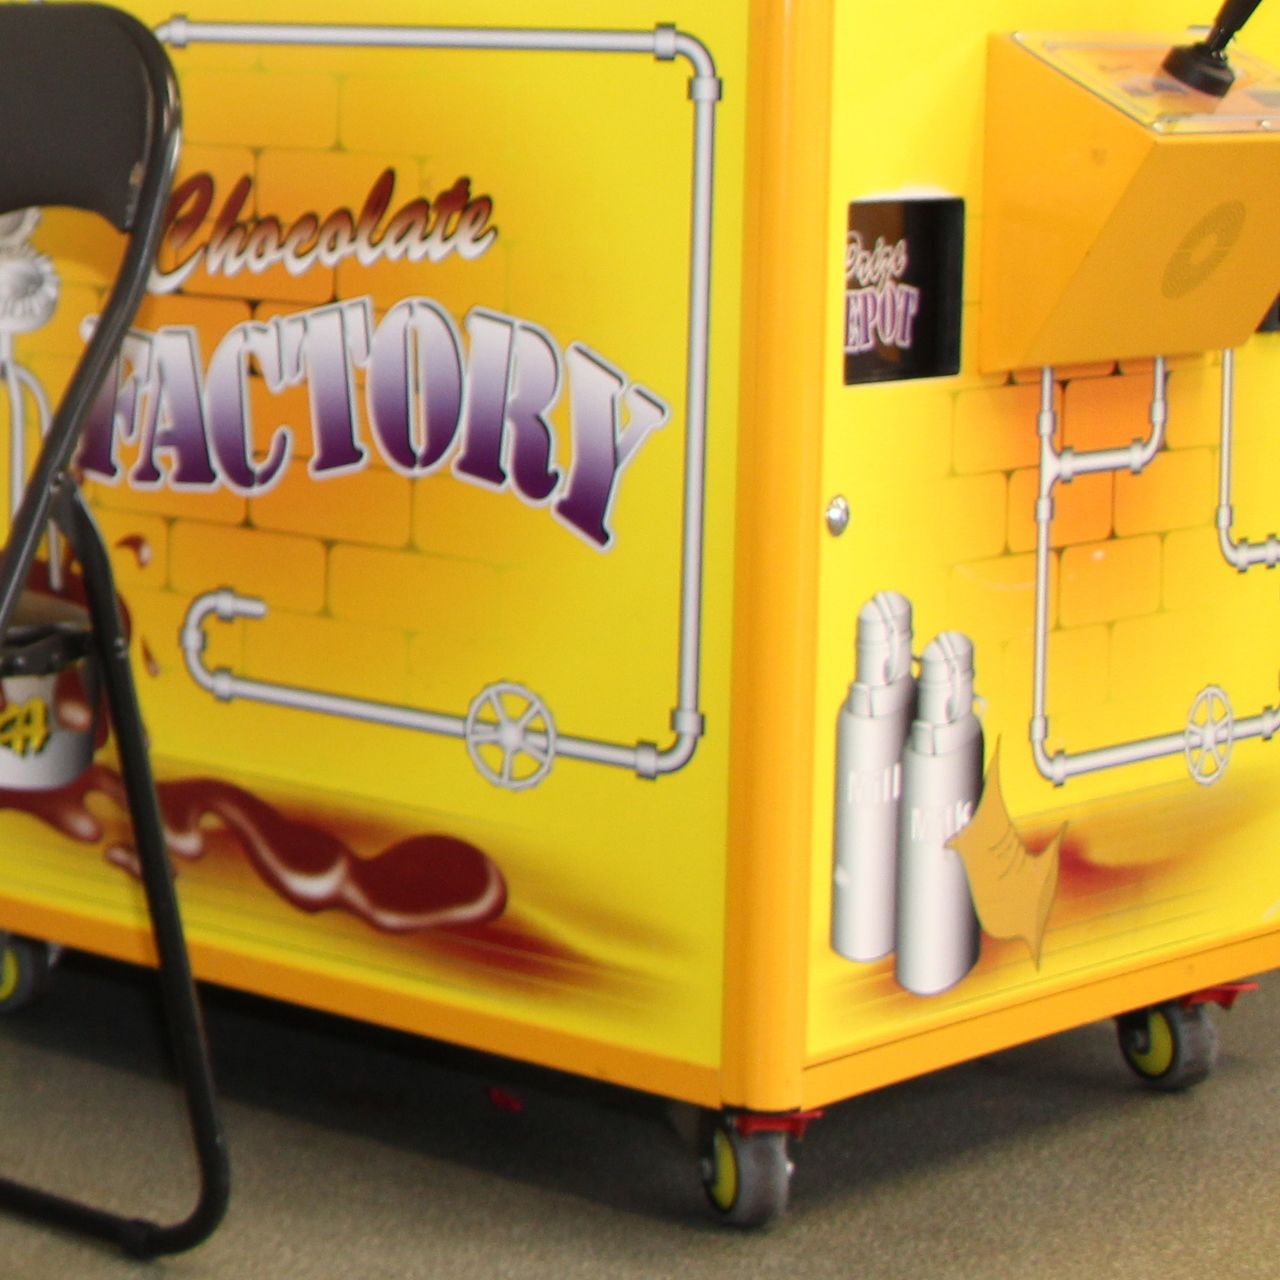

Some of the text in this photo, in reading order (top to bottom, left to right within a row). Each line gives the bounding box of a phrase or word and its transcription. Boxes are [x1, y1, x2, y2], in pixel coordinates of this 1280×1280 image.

[144, 167, 498, 295] Chocolate
[844, 280, 920, 355] EPOT
[76, 296, 670, 553] FACTORY
